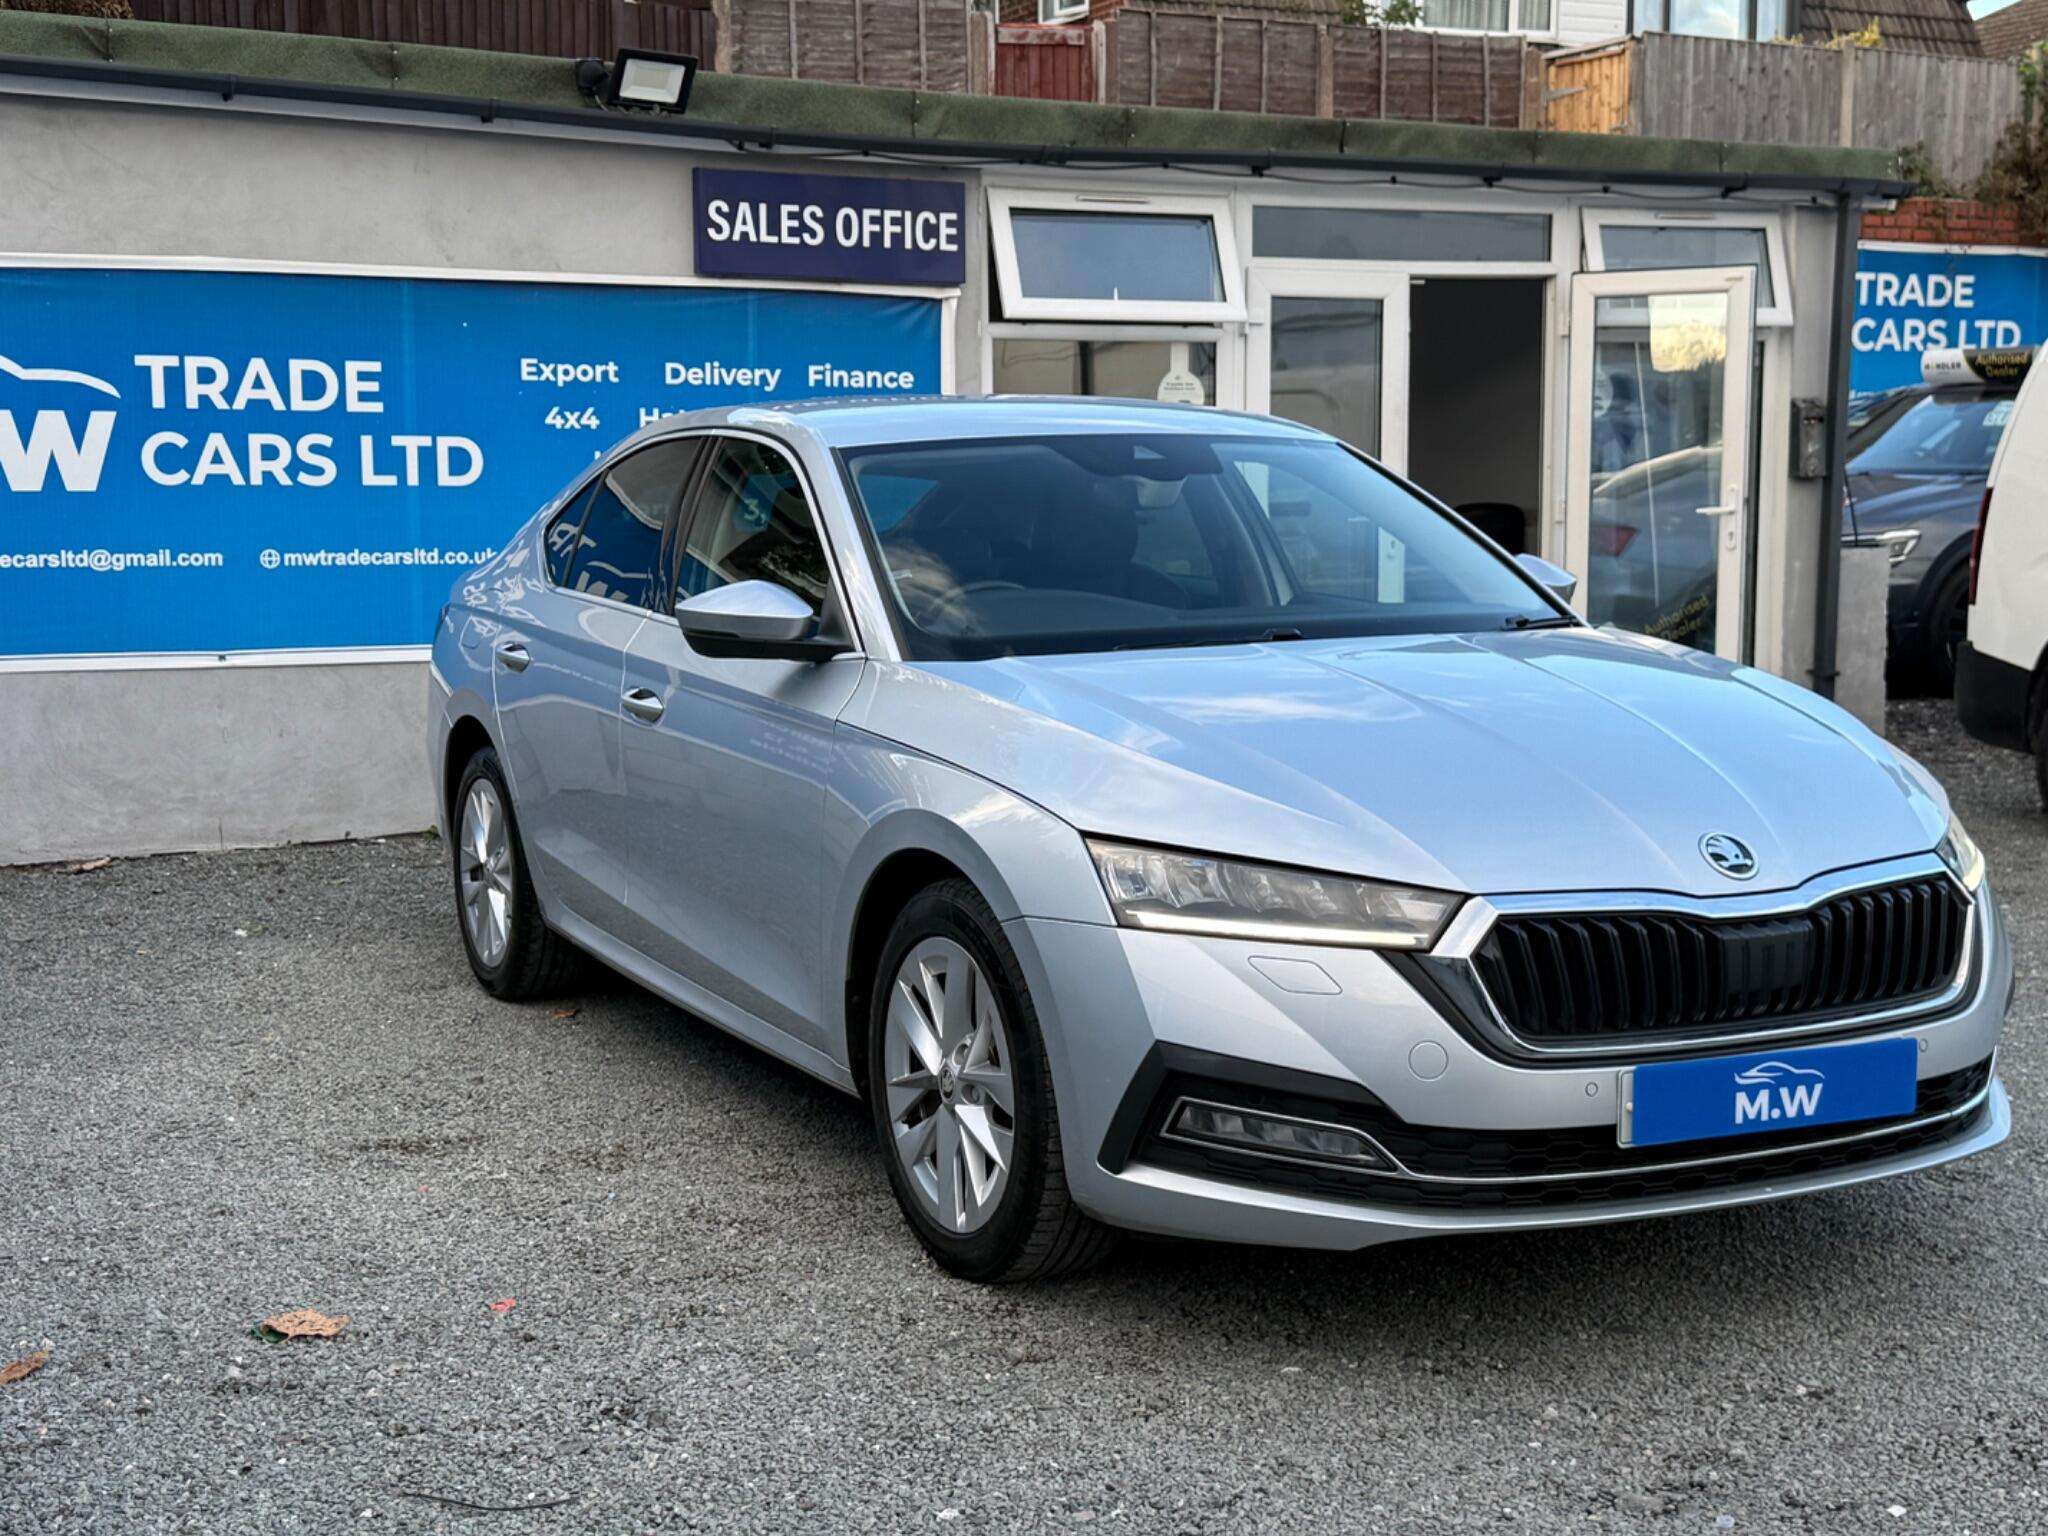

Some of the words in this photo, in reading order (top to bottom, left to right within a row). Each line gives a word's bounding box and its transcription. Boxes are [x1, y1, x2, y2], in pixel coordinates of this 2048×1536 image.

[707, 200, 825, 246] SALES
[835, 207, 958, 252] OFFICE
[1855, 272, 1976, 308] TRADE
[1851, 317, 1948, 352] CARS
[1958, 320, 2021, 349] LTD
[134, 355, 384, 413] TRADE
[520, 358, 619, 387] Export
[665, 361, 781, 392] Delivery
[808, 363, 914, 389] Finance
[544, 407, 600, 429] 4x4
[141, 431, 338, 487] CARS
[360, 435, 484, 487] LTD
[1735, 1083, 1823, 1124] M.W
